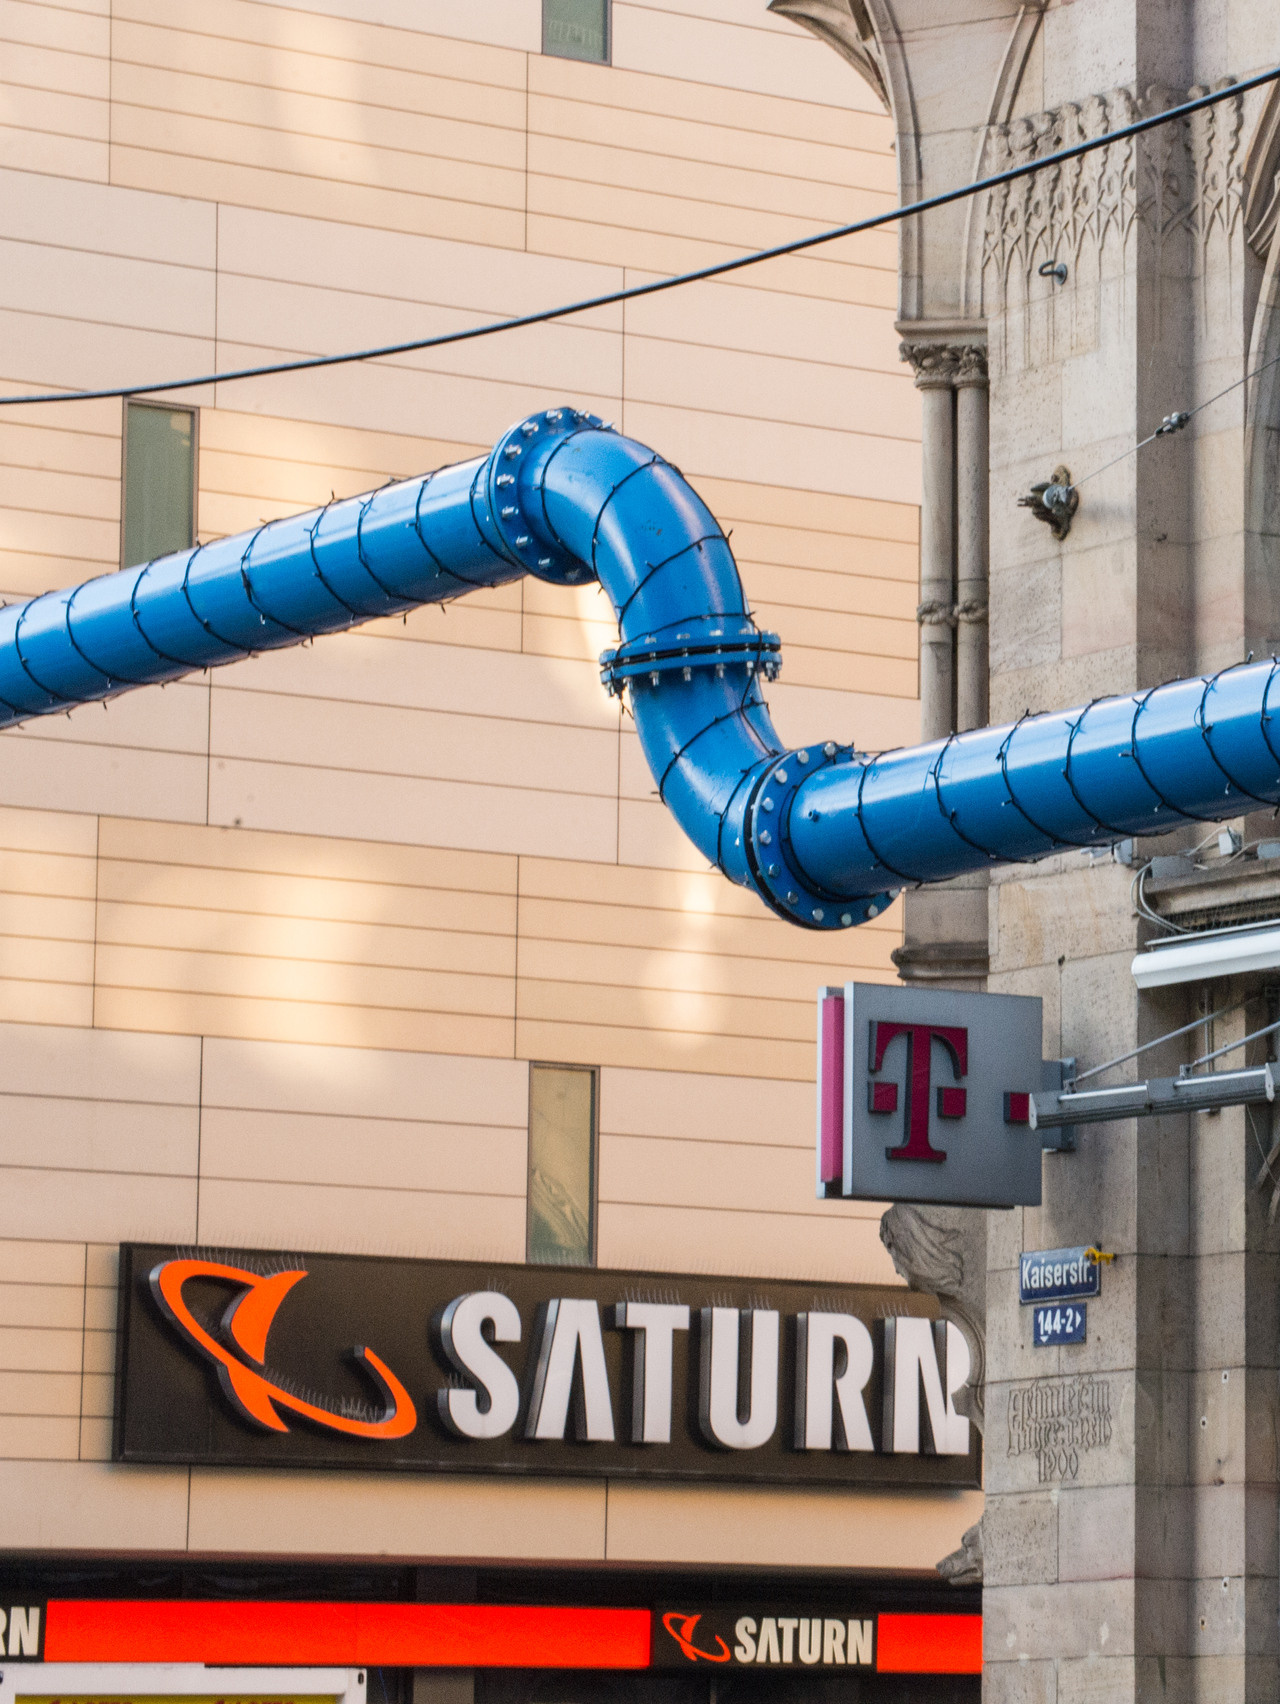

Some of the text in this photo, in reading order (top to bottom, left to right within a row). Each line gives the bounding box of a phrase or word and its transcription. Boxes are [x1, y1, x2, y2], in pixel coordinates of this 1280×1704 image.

[1022, 1256, 1093, 1290] Kaiserstr.
[1038, 1307, 1074, 1336] 144-2
[438, 1291, 970, 1456] SATURN
[734, 1616, 873, 1664] SATURN
